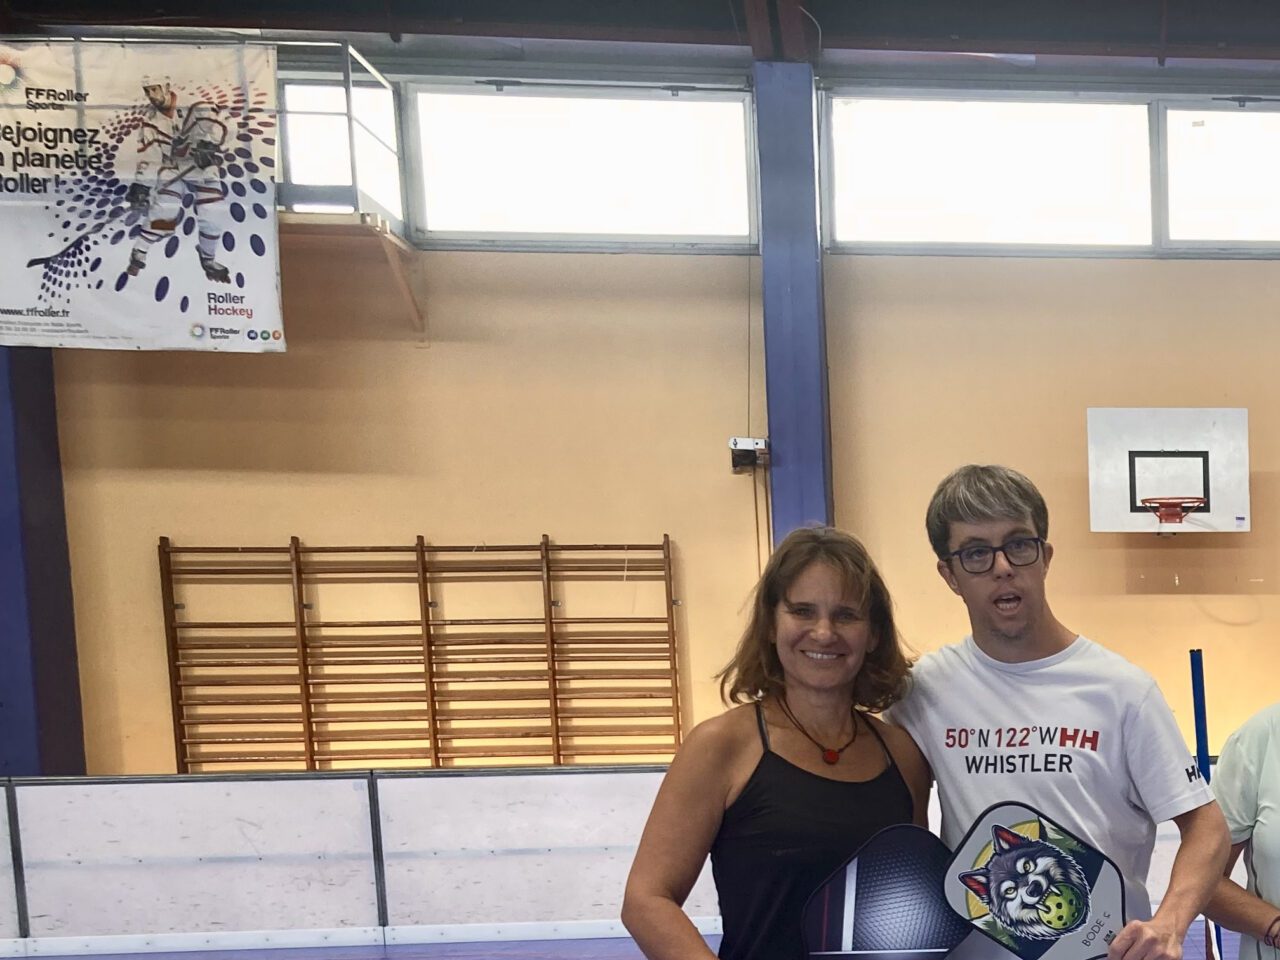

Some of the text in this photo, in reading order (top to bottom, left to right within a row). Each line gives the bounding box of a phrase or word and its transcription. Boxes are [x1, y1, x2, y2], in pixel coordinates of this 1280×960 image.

[25, 87, 89, 102] FFRoller
[0, 121, 101, 150] ejoignez
[12, 147, 102, 172] planète
[0, 173, 51, 194] oller
[207, 292, 245, 305] Roller
[208, 304, 253, 319] Hockey
[965, 753, 1073, 774] WHISTLER
[1081, 918, 1105, 948] BODE
